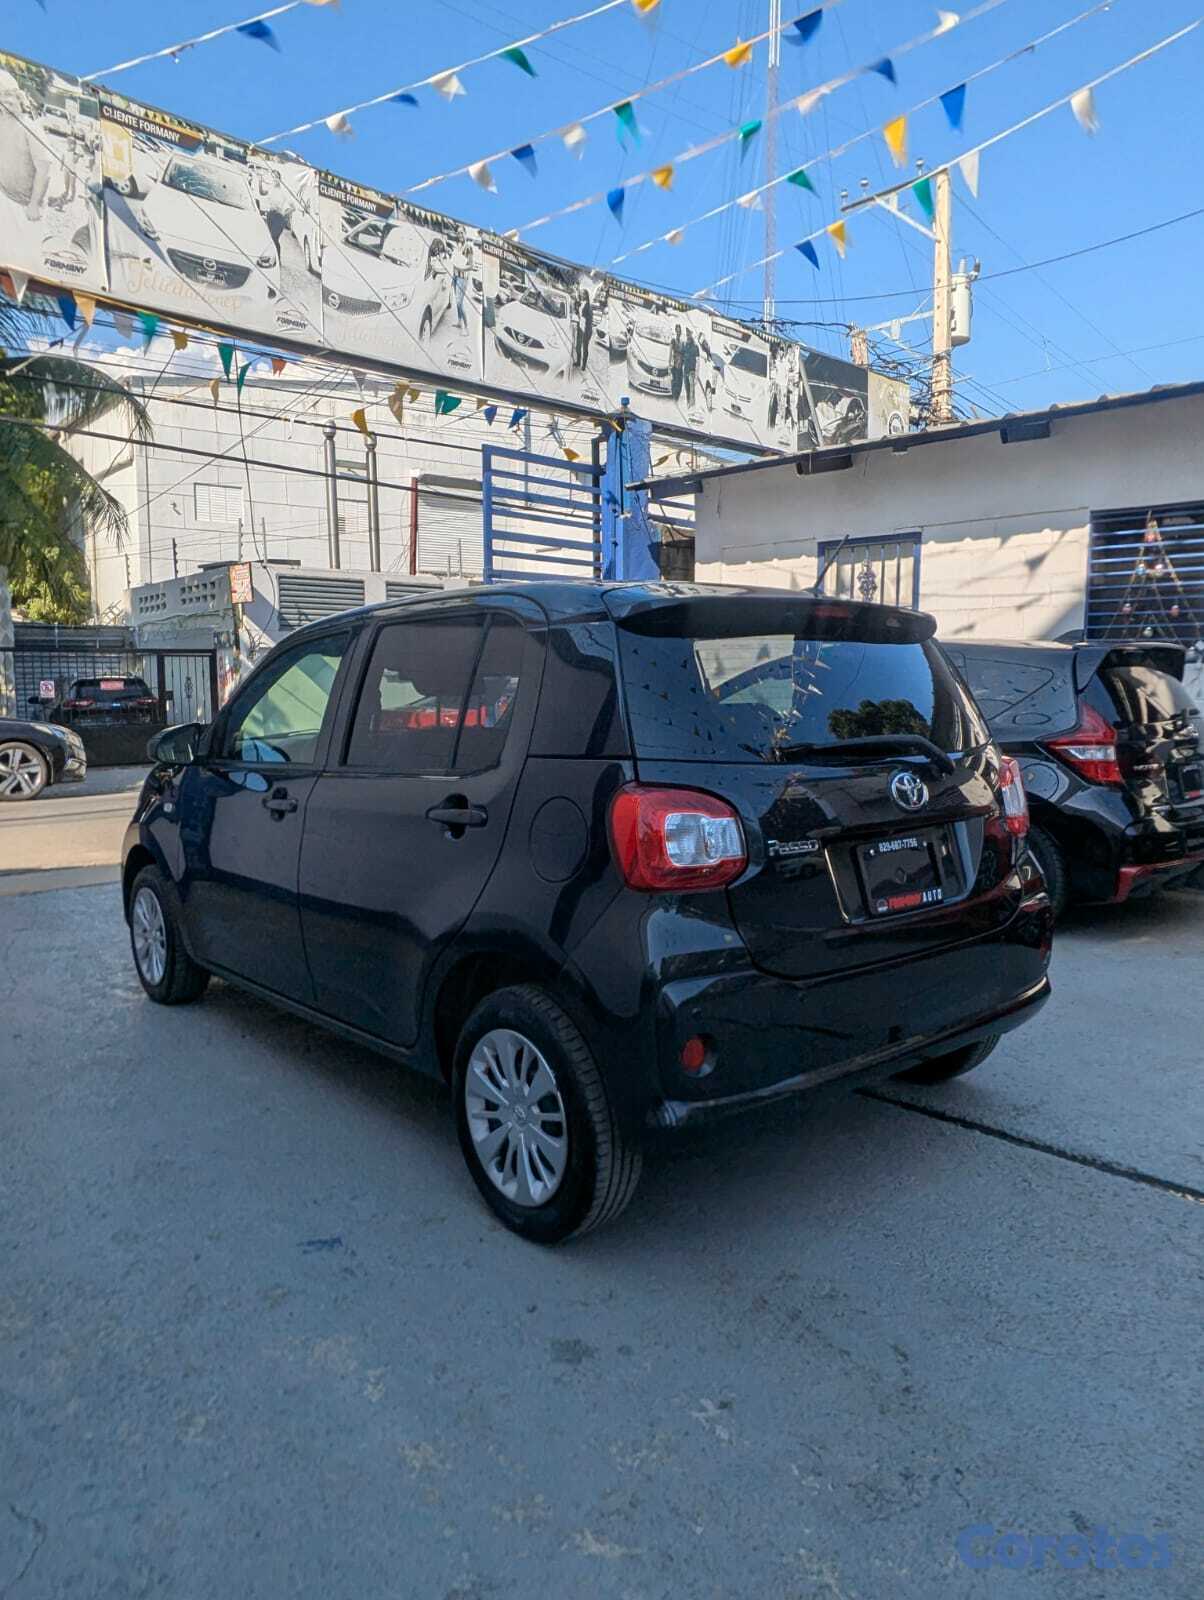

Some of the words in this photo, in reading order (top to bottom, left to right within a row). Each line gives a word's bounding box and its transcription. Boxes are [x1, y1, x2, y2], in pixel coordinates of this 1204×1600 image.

[103, 105, 138, 128] CLIENTE
[139, 119, 180, 143] FORMANY
[320, 184, 346, 201] CLIENTE
[346, 194, 376, 212] FORMANY
[922, 888, 942, 902] AUTO
